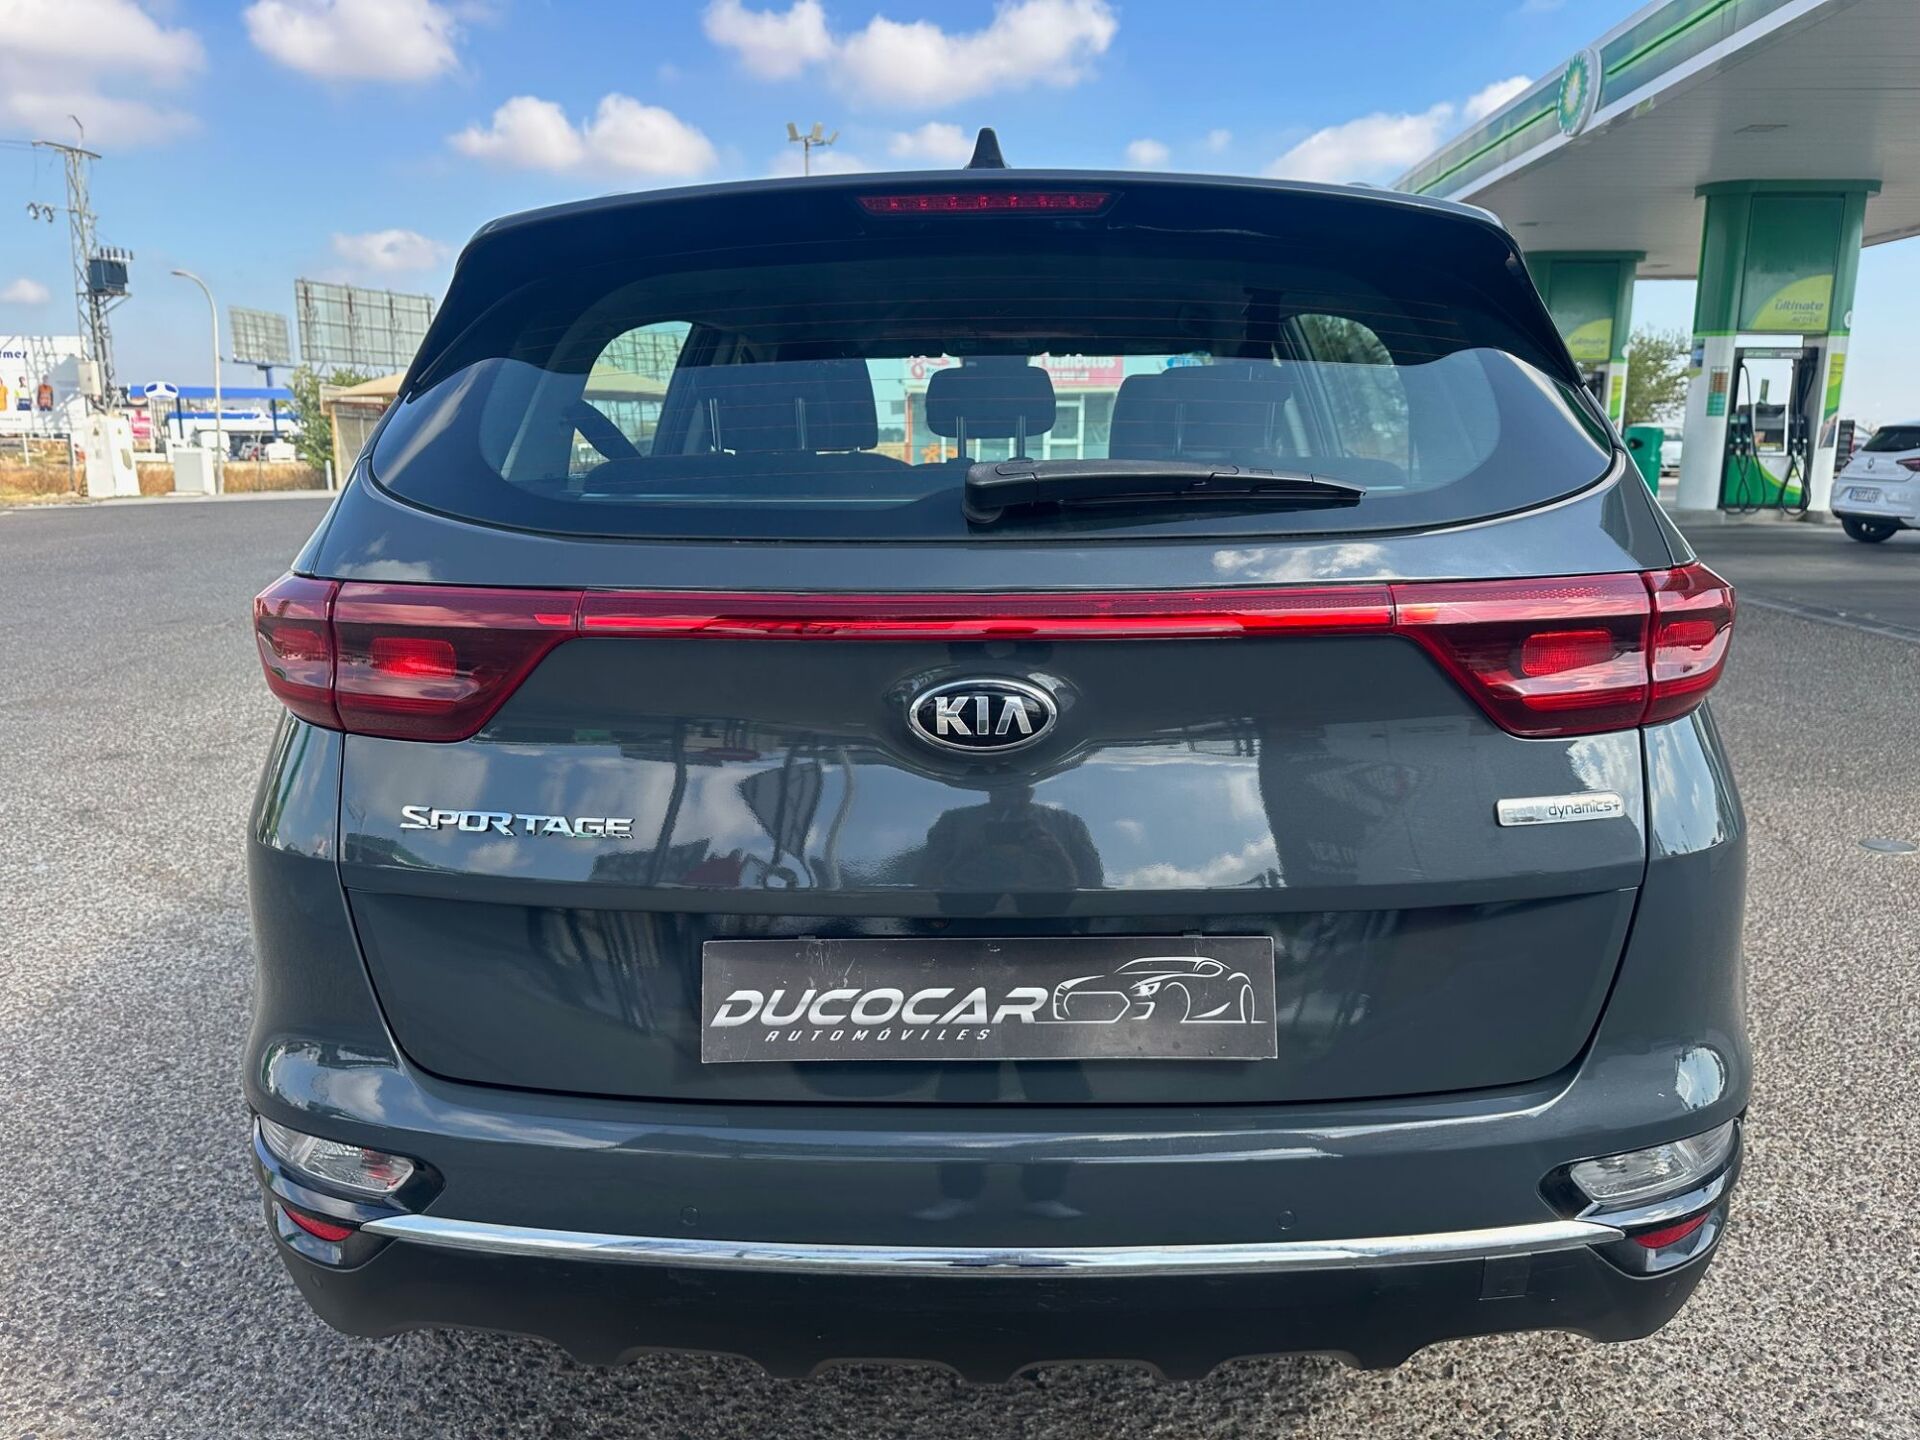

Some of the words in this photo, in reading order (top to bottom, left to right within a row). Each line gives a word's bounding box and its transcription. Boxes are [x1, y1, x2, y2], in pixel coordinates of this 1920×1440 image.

[934, 696, 1033, 735] KIA
[399, 805, 635, 839] SPORTAGE
[710, 986, 1050, 1027] DUCOCAR
[764, 1027, 991, 1042] AUTOMÓVILES
